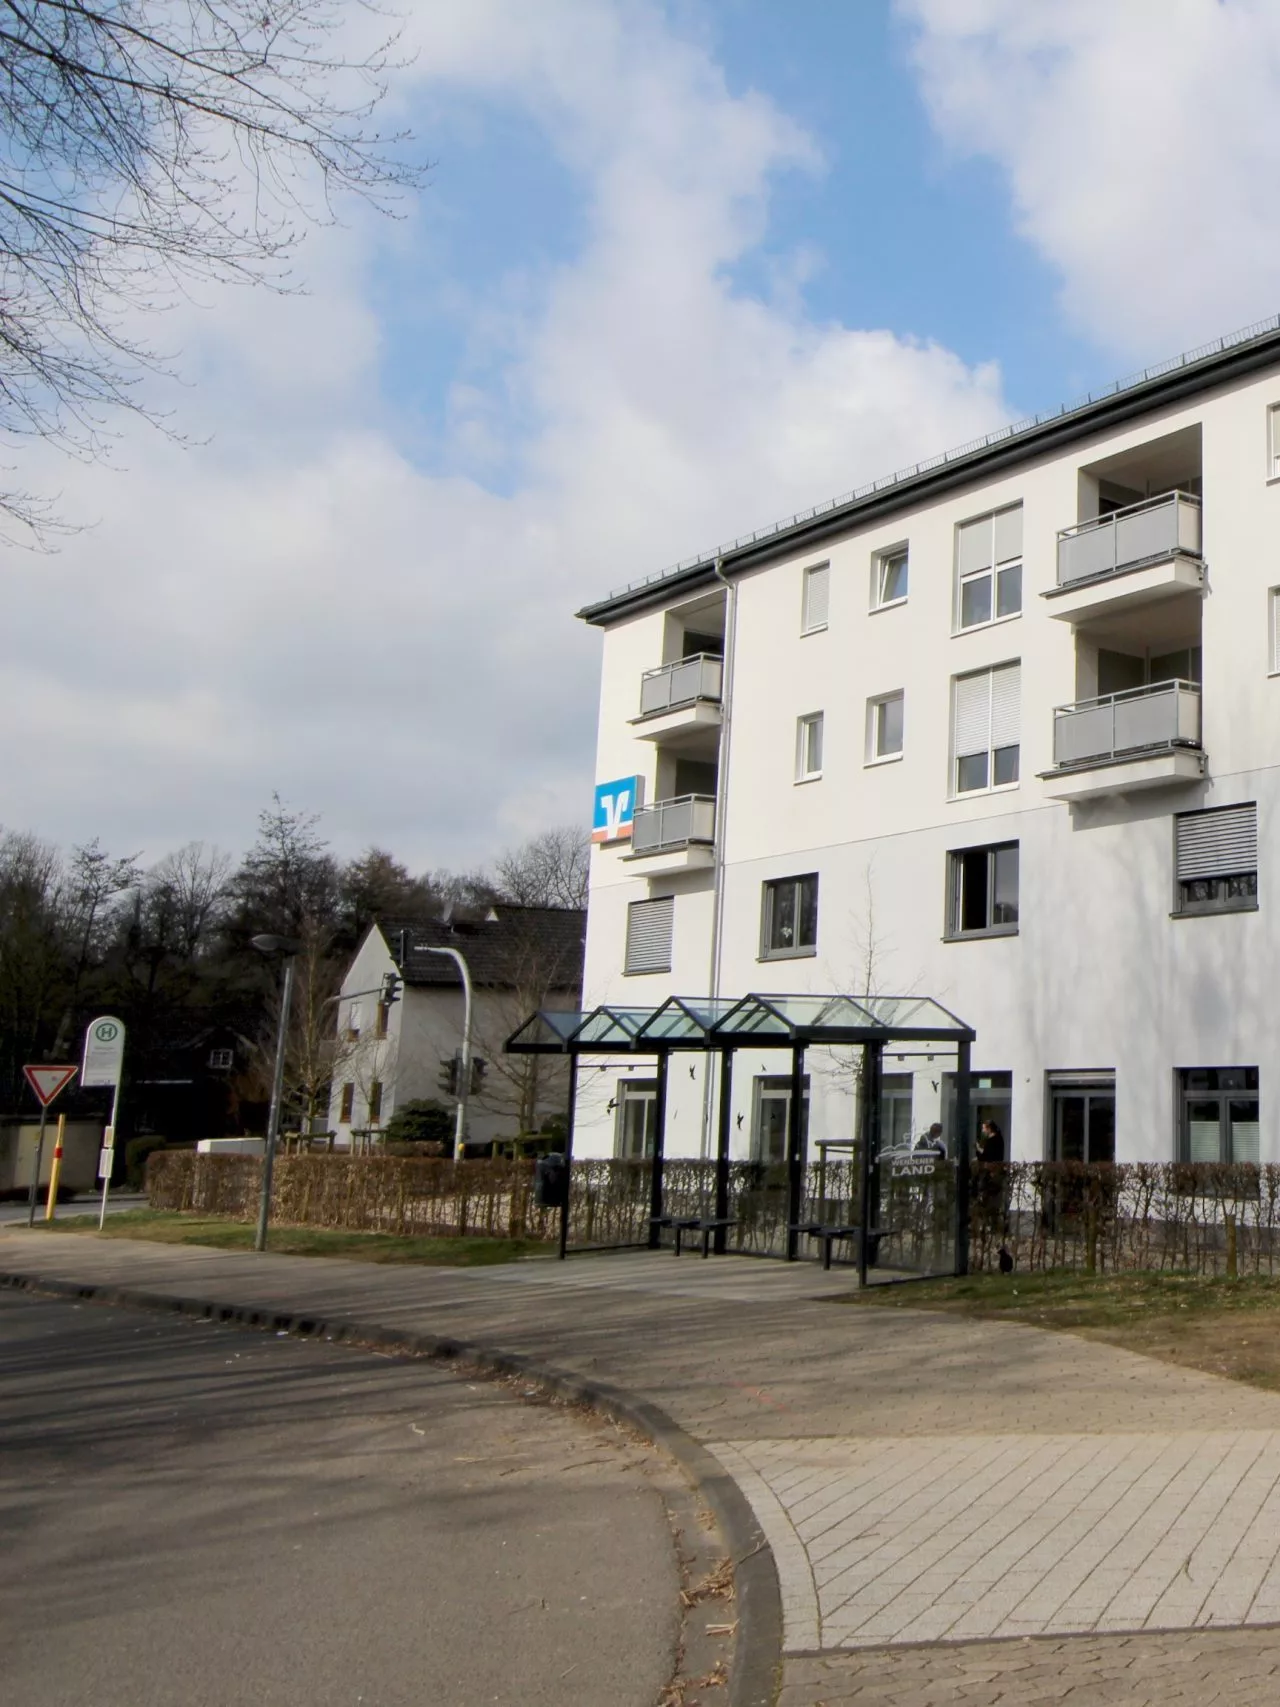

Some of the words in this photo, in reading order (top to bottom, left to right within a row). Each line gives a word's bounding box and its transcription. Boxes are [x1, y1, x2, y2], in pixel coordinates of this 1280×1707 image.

[101, 1027, 113, 1038] H
[891, 1158, 935, 1167] WENDENER
[891, 1165, 936, 1177] LAND
